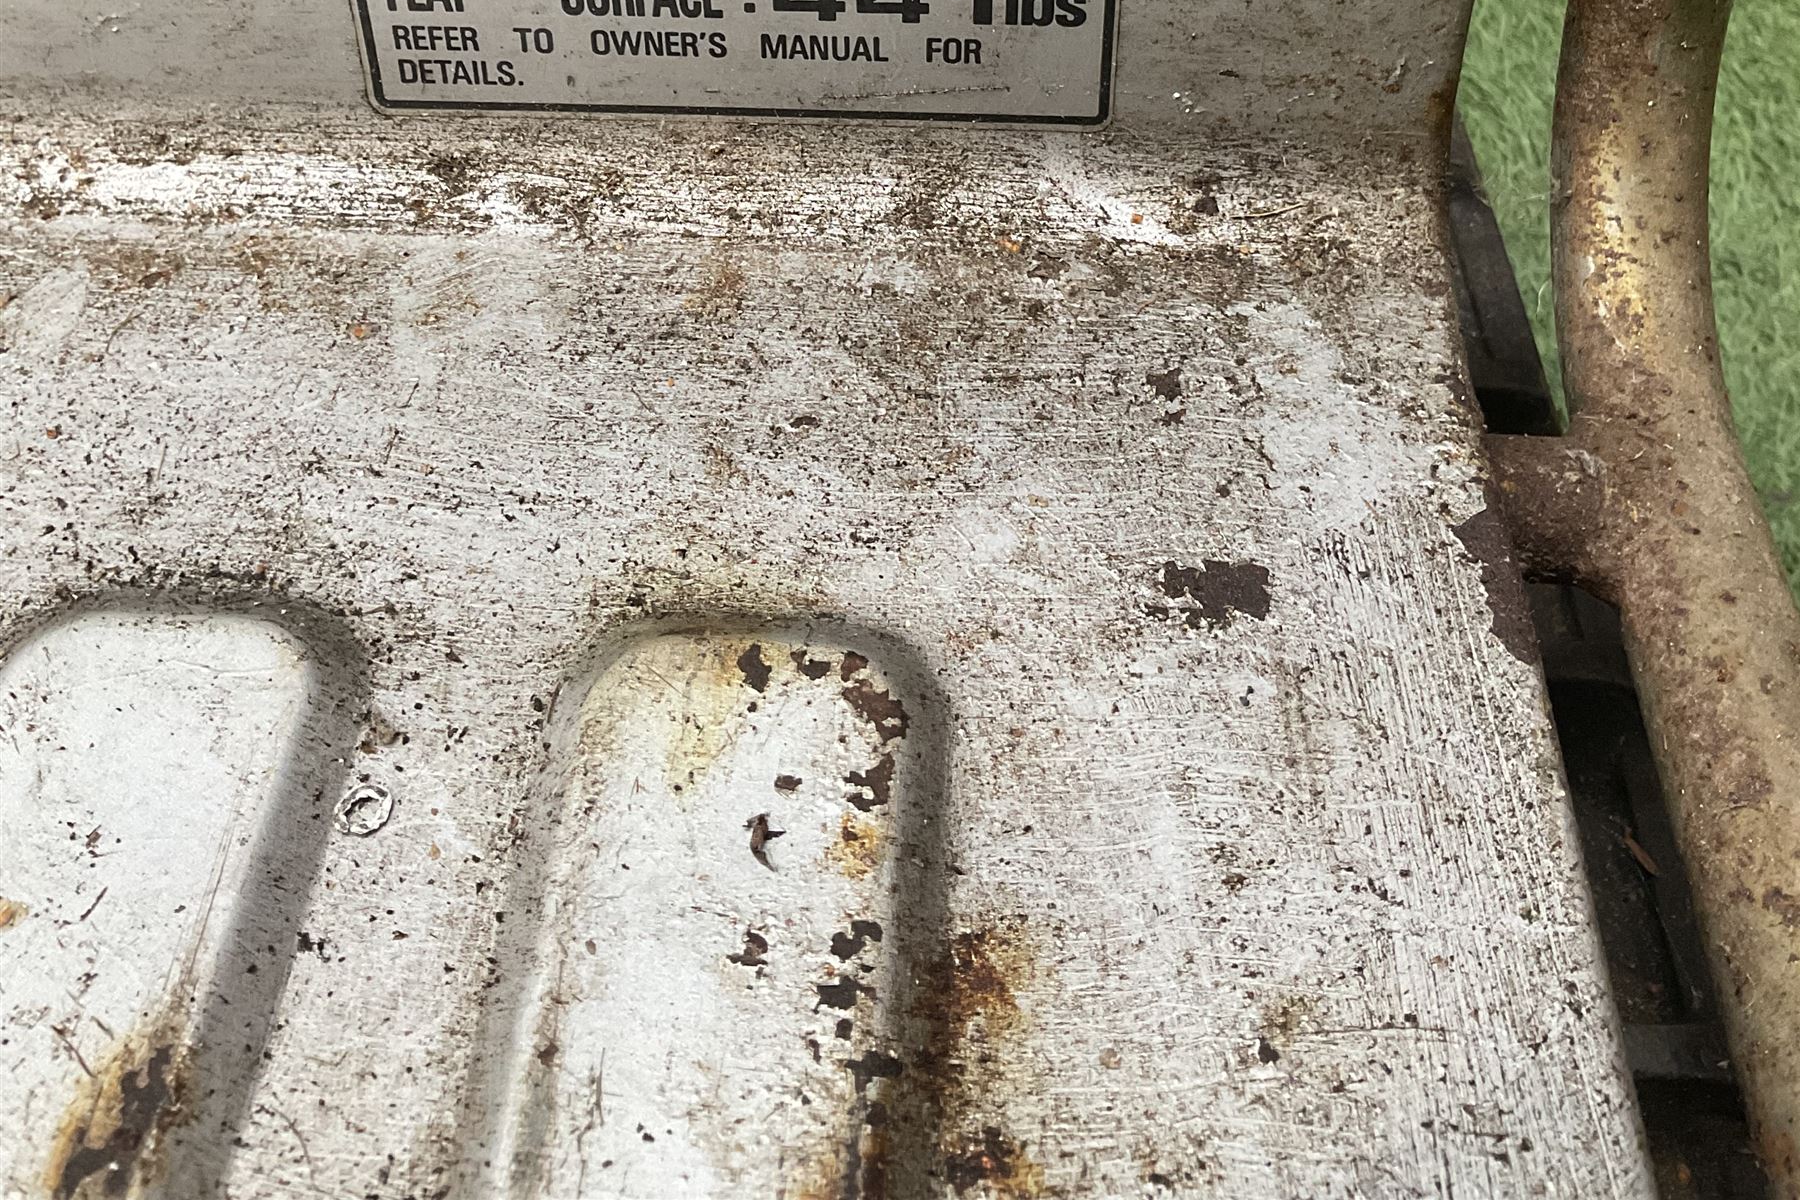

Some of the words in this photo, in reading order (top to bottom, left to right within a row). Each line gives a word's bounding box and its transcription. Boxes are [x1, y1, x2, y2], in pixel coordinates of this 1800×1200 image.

[392, 25, 479, 52] REFER
[513, 28, 554, 54] TO
[591, 30, 727, 58] OWNER'S
[760, 33, 889, 62] MANUAL
[926, 37, 982, 64] FOR
[399, 59, 525, 87] DETAILS.
